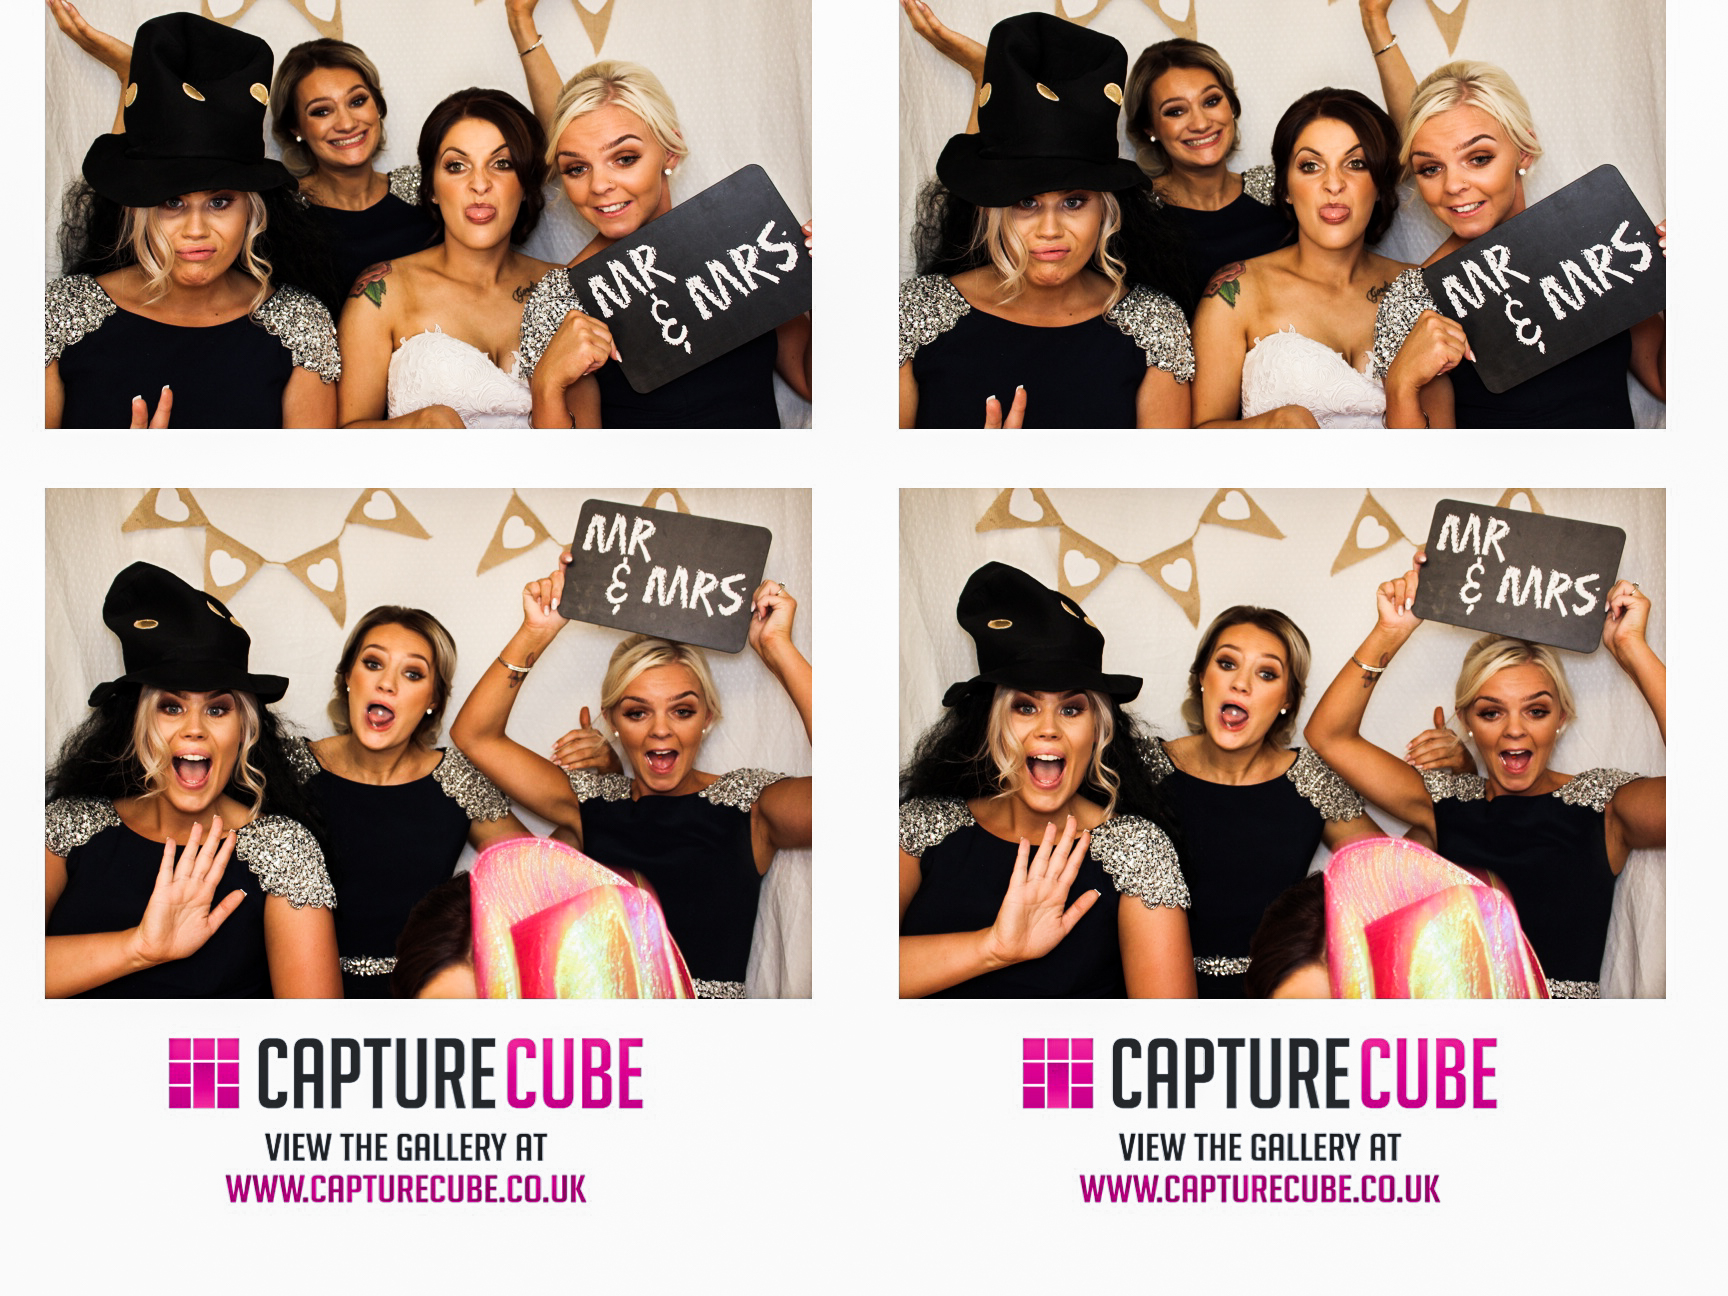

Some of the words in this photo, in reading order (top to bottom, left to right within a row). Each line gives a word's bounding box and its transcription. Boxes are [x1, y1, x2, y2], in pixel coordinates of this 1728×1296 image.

[587, 244, 677, 318] MR
[650, 292, 692, 354] &
[685, 220, 799, 321] MRS
[1441, 244, 1531, 318] MR
[1504, 292, 1546, 354] &
[1539, 220, 1653, 321] MRS
[582, 512, 656, 563] MR
[1436, 512, 1510, 563] MR
[605, 556, 631, 616] &
[641, 565, 747, 618] MRS
[1459, 556, 1485, 616] &
[1495, 565, 1601, 618] MRS
